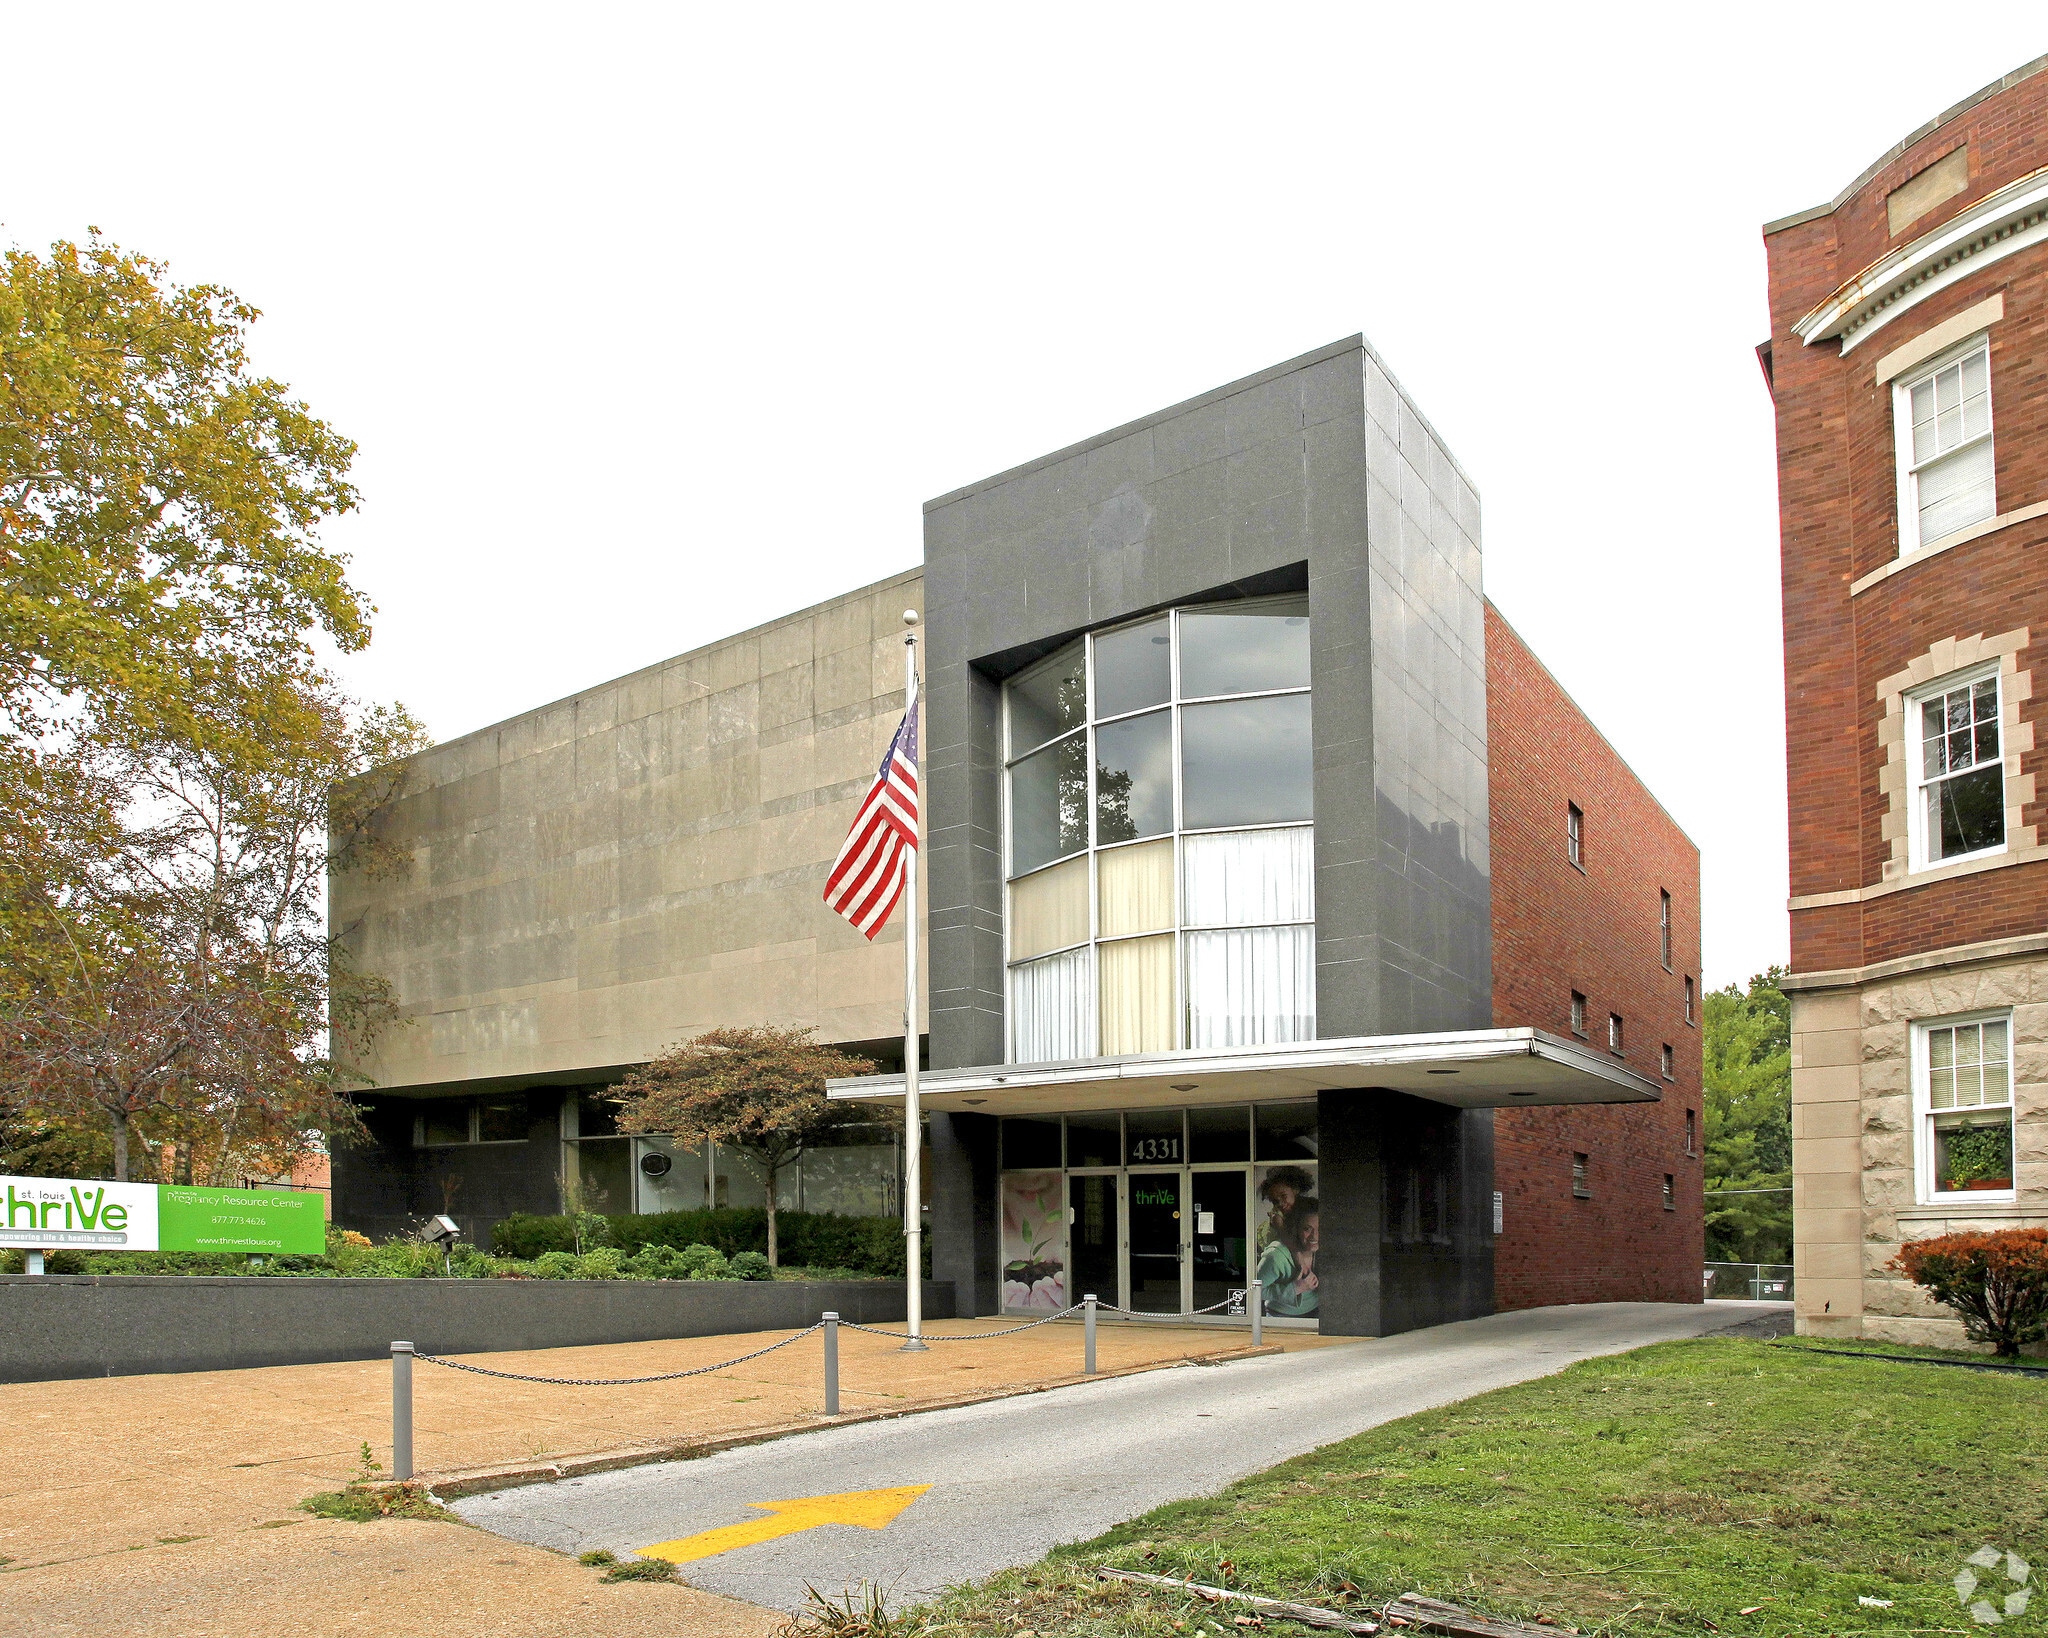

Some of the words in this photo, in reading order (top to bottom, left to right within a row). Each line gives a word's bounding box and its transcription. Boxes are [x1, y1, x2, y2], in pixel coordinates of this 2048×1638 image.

[1133, 1138, 1179, 1160] 4331
[21, 1190, 35, 1199] st.
[39, 1190, 66, 1201] louis
[167, 1192, 220, 1206] Pregnancy
[223, 1194, 269, 1208] Resource
[271, 1197, 305, 1209] Center
[0, 1185, 128, 1231] hriVe
[43, 1233, 57, 1241] life
[68, 1234, 96, 1243] healthy
[98, 1235, 123, 1243] choice
[195, 1236, 282, 1249] www.thrivestlouis.org
